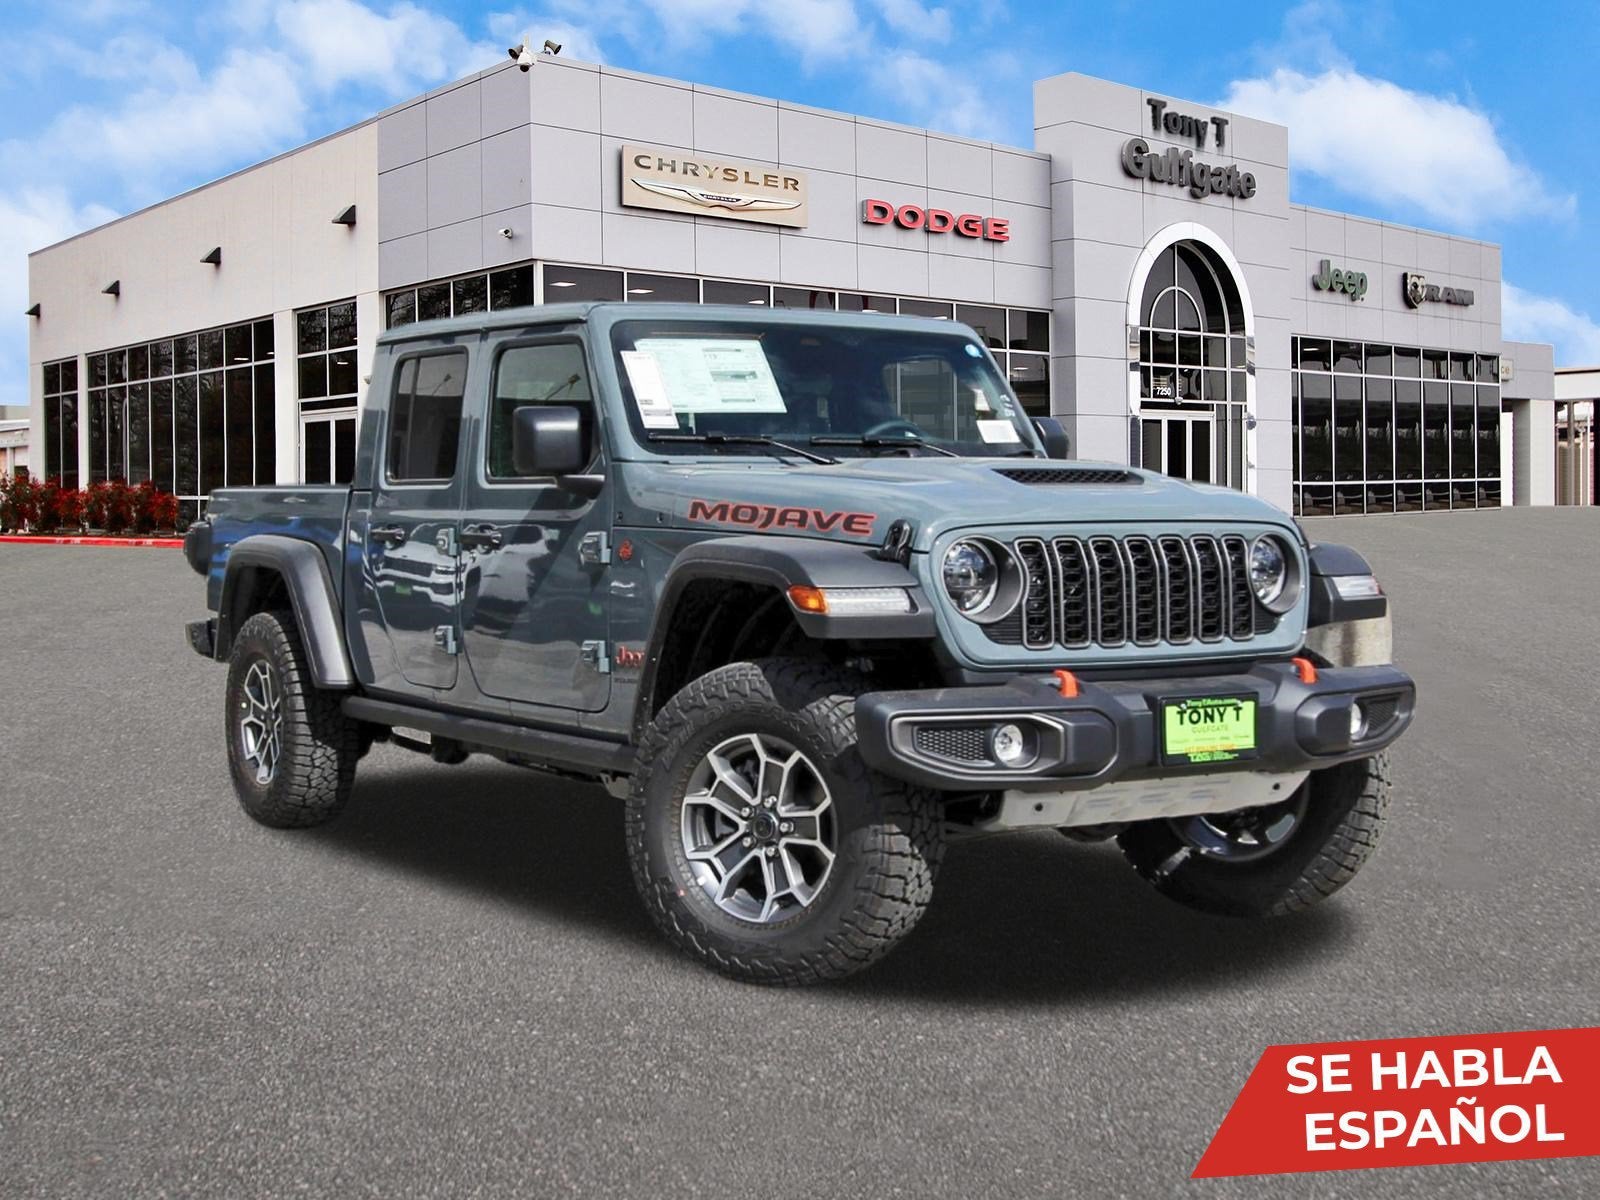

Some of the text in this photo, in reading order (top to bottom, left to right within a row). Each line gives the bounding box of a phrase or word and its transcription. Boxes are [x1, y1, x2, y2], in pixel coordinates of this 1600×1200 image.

[1147, 98, 1229, 148] Tony T
[633, 153, 800, 192] CHRYSLER
[1121, 138, 1257, 199] Gulfgate
[863, 198, 1010, 243] DODGE
[1312, 259, 1368, 302] Jeep
[1425, 283, 1475, 306] RAM
[1156, 386, 1172, 396] 7250
[688, 499, 877, 536] MOJAVE
[1176, 705, 1243, 726] TONY T
